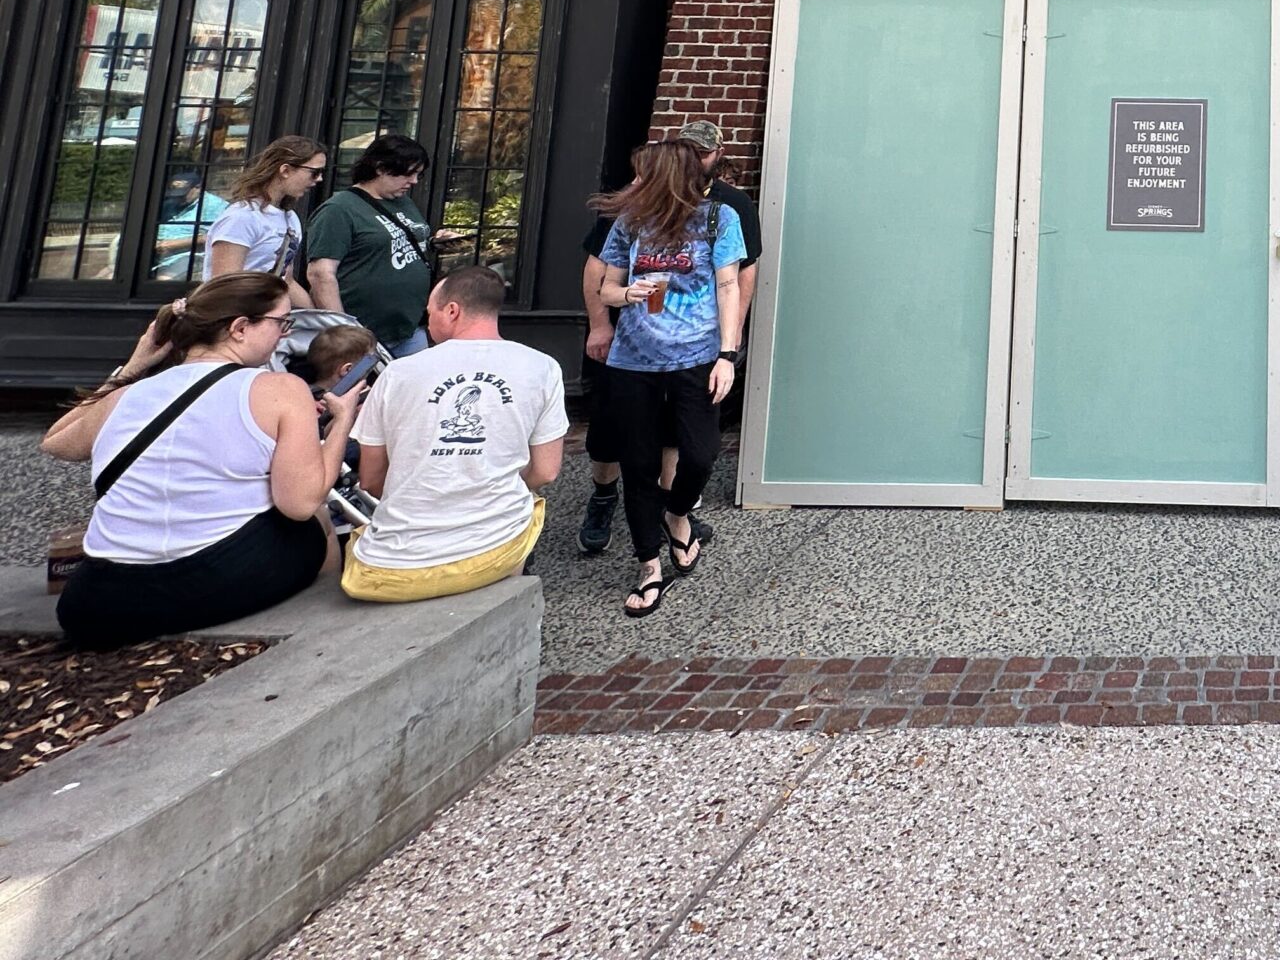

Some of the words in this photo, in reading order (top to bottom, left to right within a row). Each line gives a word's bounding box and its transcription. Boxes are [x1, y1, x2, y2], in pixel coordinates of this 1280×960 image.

[1133, 121, 1156, 130] THIS
[1159, 121, 1185, 131] AREA
[1137, 133, 1147, 142] IS
[1150, 133, 1179, 142] BEING
[1125, 144, 1191, 154] REFURBISHED
[1133, 156, 1153, 165] FOR
[1156, 156, 1182, 165] YOUR
[1138, 167, 1176, 177] FUTURE
[1127, 179, 1187, 189] ENJOYMENT
[1137, 208, 1173, 218] SPRINGS
[634, 252, 694, 273] BILLS
[428, 373, 466, 404] LONG
[472, 372, 513, 404] BEACH
[430, 448, 455, 456] NEW
[458, 448, 483, 456] YORK
